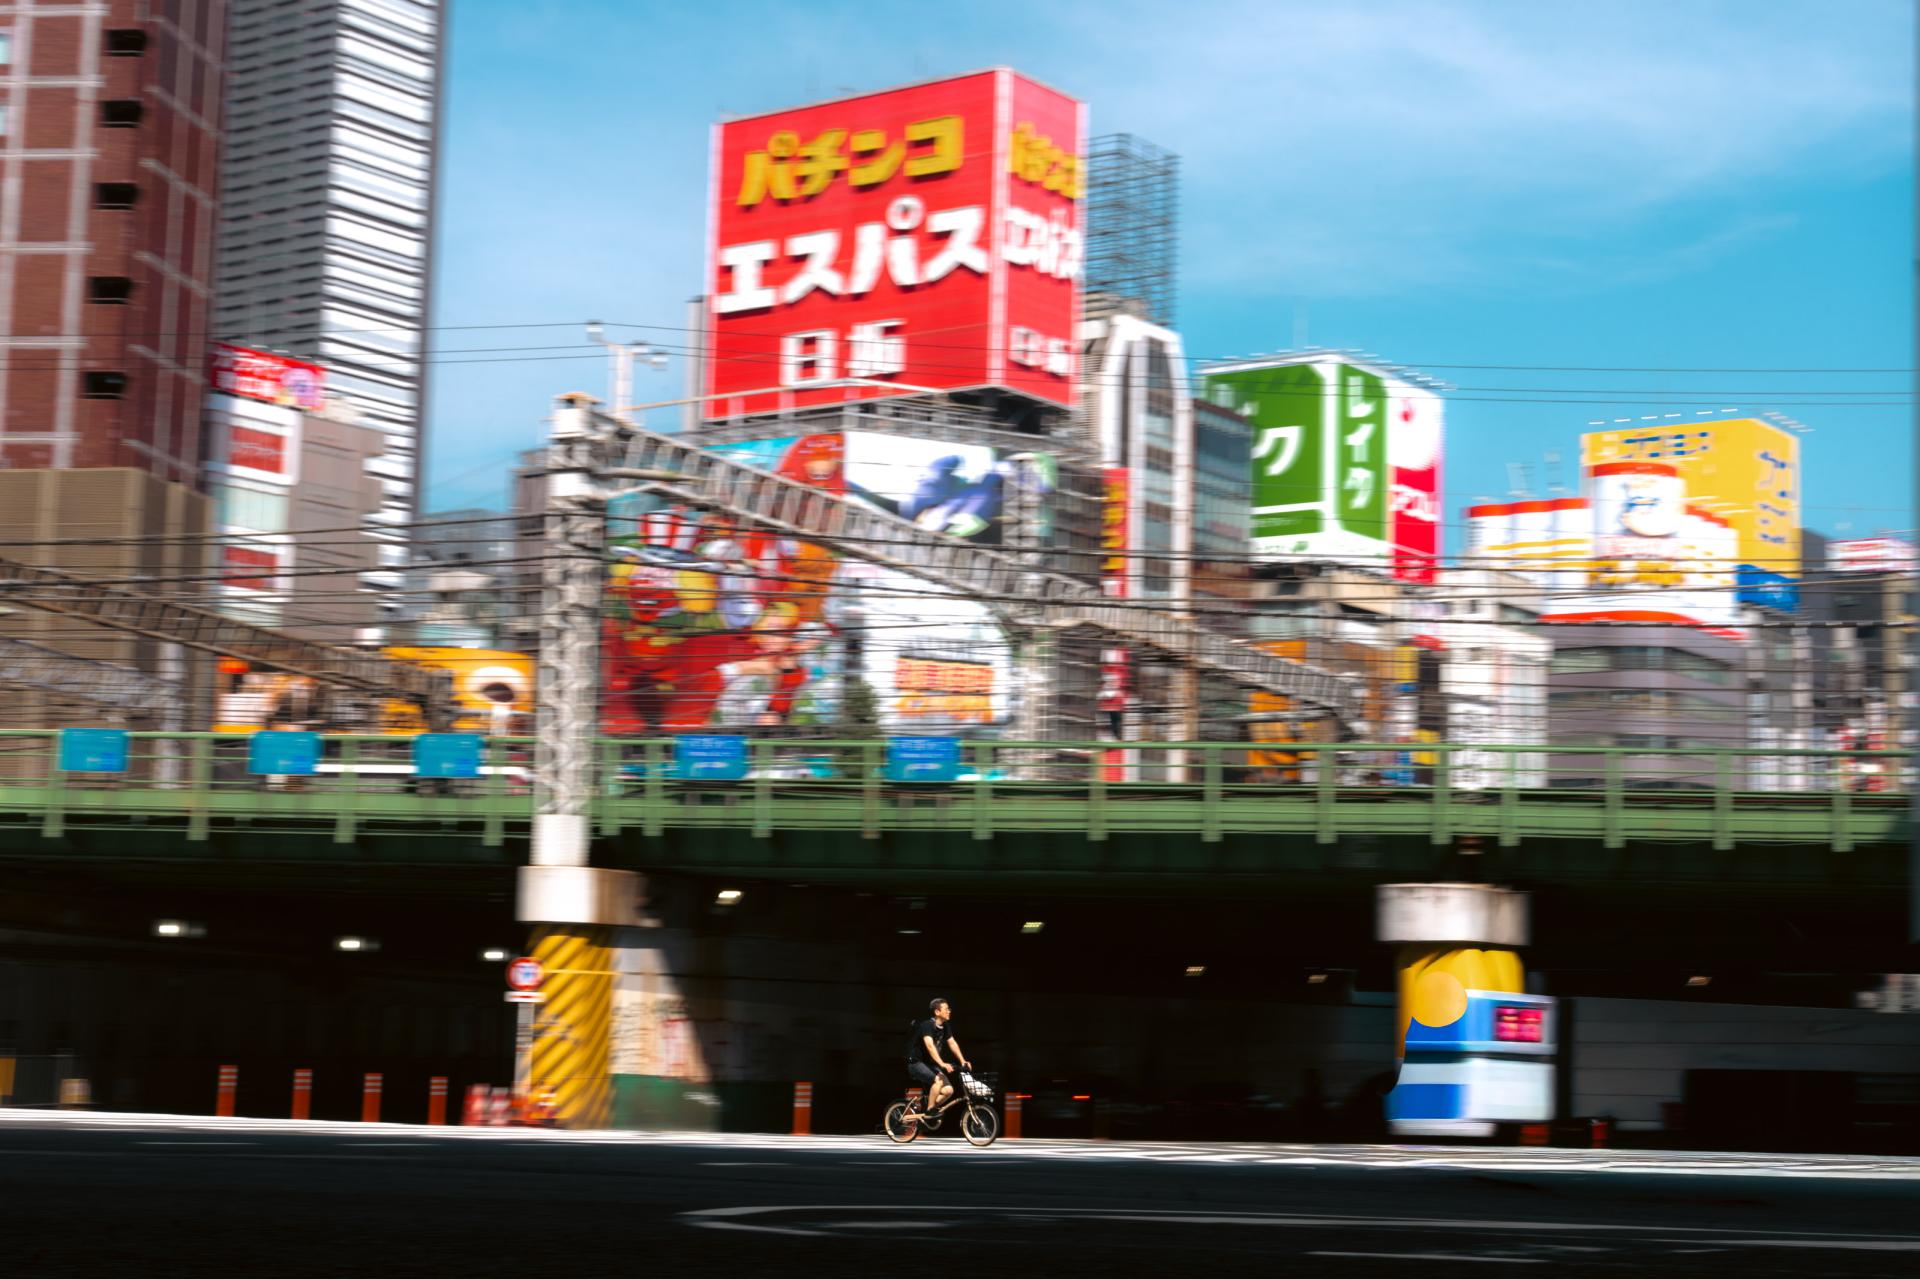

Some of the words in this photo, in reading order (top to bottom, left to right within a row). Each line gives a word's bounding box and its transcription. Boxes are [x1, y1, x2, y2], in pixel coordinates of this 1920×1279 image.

[737, 116, 963, 206] パチンコ
[712, 196, 989, 315] エスパス
[1344, 376, 1376, 510] レイク
